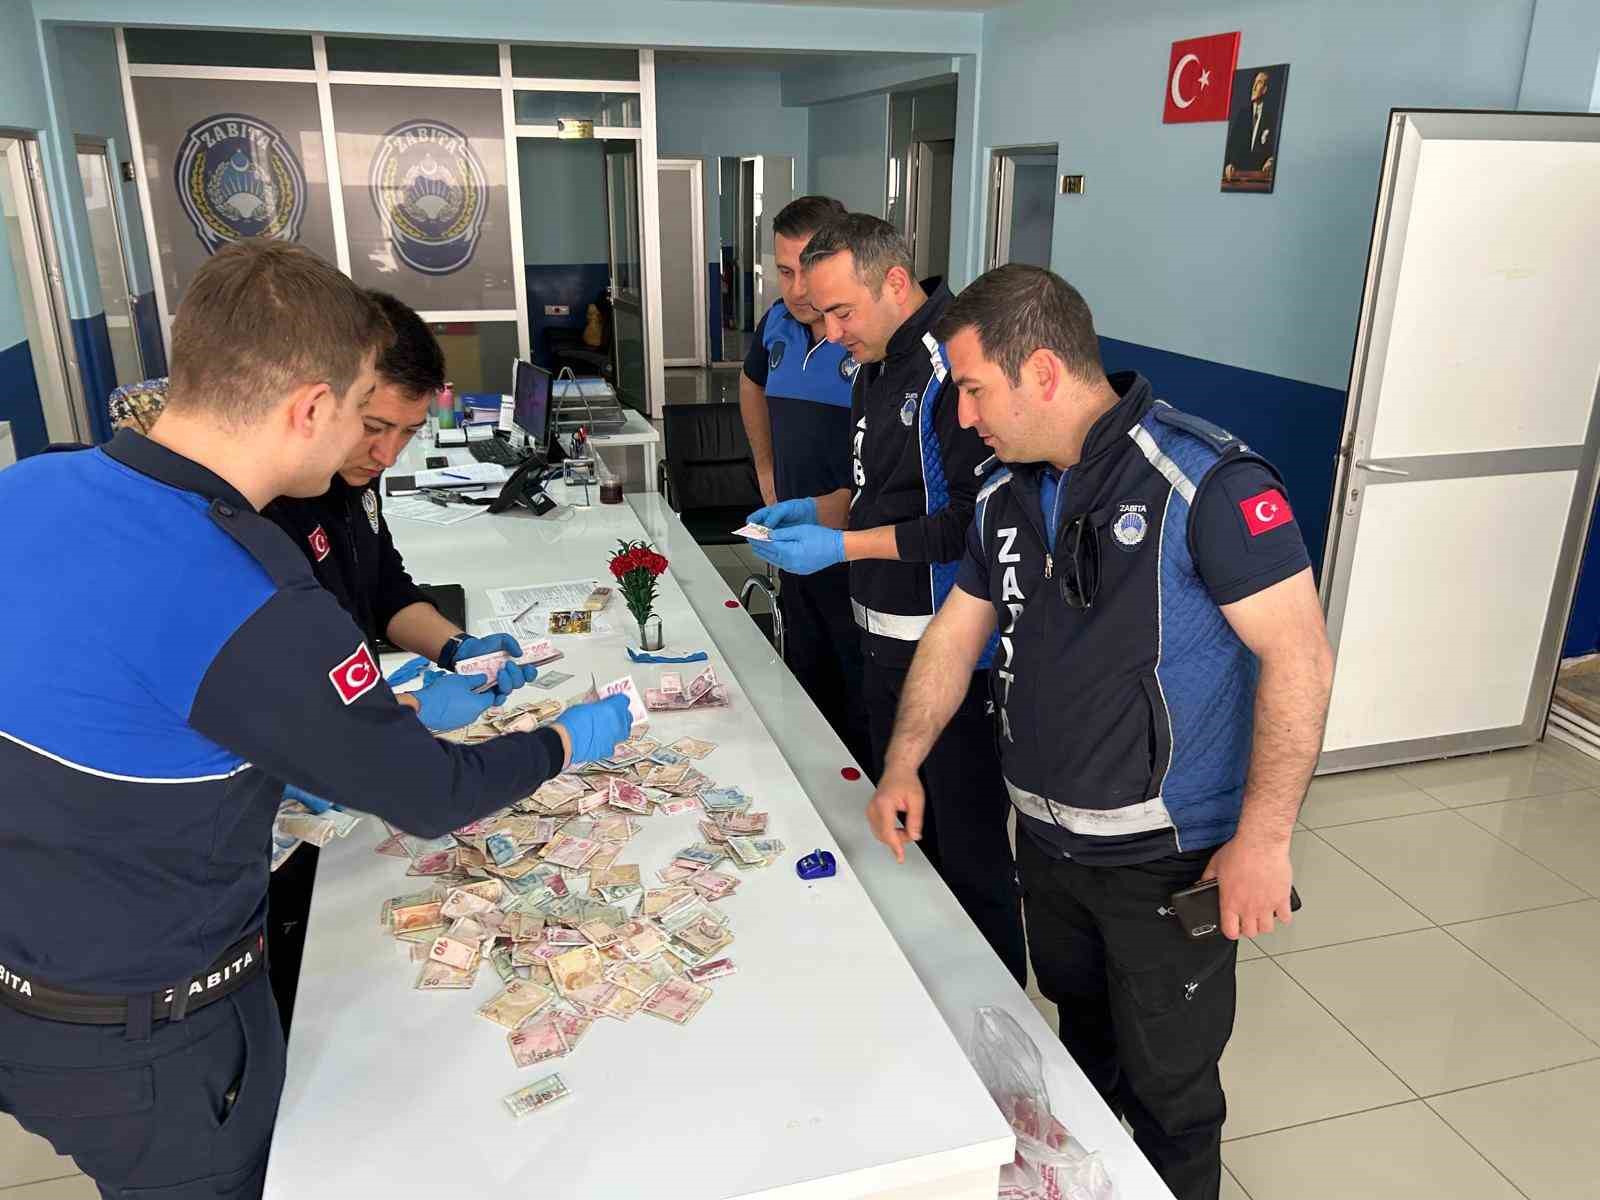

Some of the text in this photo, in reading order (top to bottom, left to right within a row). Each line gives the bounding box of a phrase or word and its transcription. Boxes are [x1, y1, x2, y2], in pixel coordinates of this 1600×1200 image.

[201, 122, 270, 148] ZABITA
[394, 127, 457, 153] ZABITA
[1119, 503, 1147, 513] ZABITA
[997, 527, 1026, 743] ZABITA
